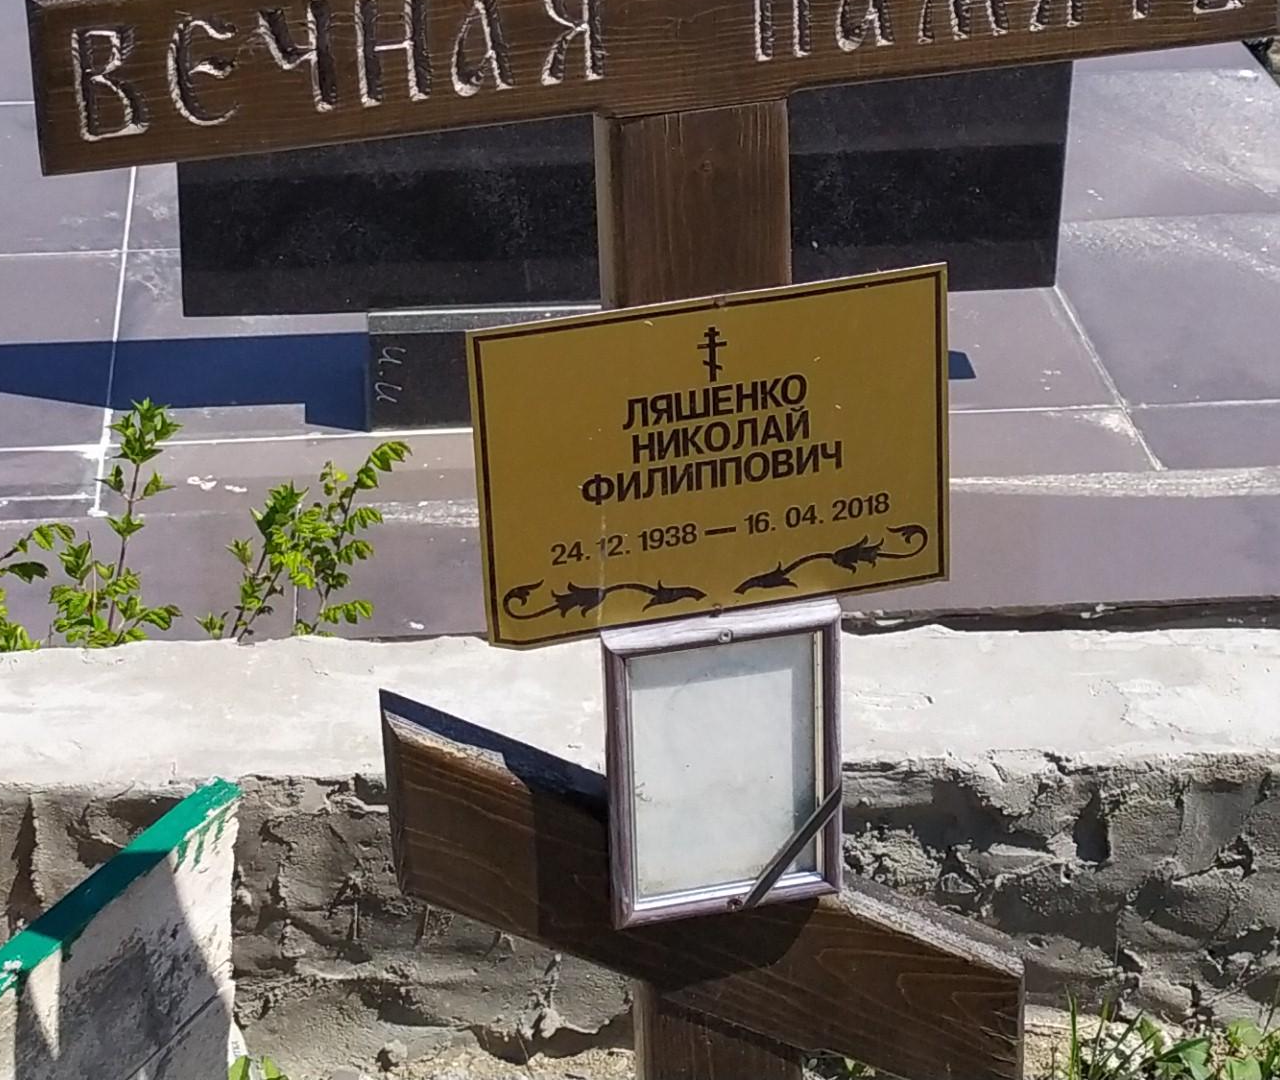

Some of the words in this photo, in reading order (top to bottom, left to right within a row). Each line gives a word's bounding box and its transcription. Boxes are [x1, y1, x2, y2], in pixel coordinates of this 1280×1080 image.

[622, 373, 808, 430] ЛЯШЕНКО
[631, 407, 810, 464] НИКОЛАЙ
[581, 440, 843, 506] ФИЛИППОВИЧ
[832, 492, 890, 521] 2018
